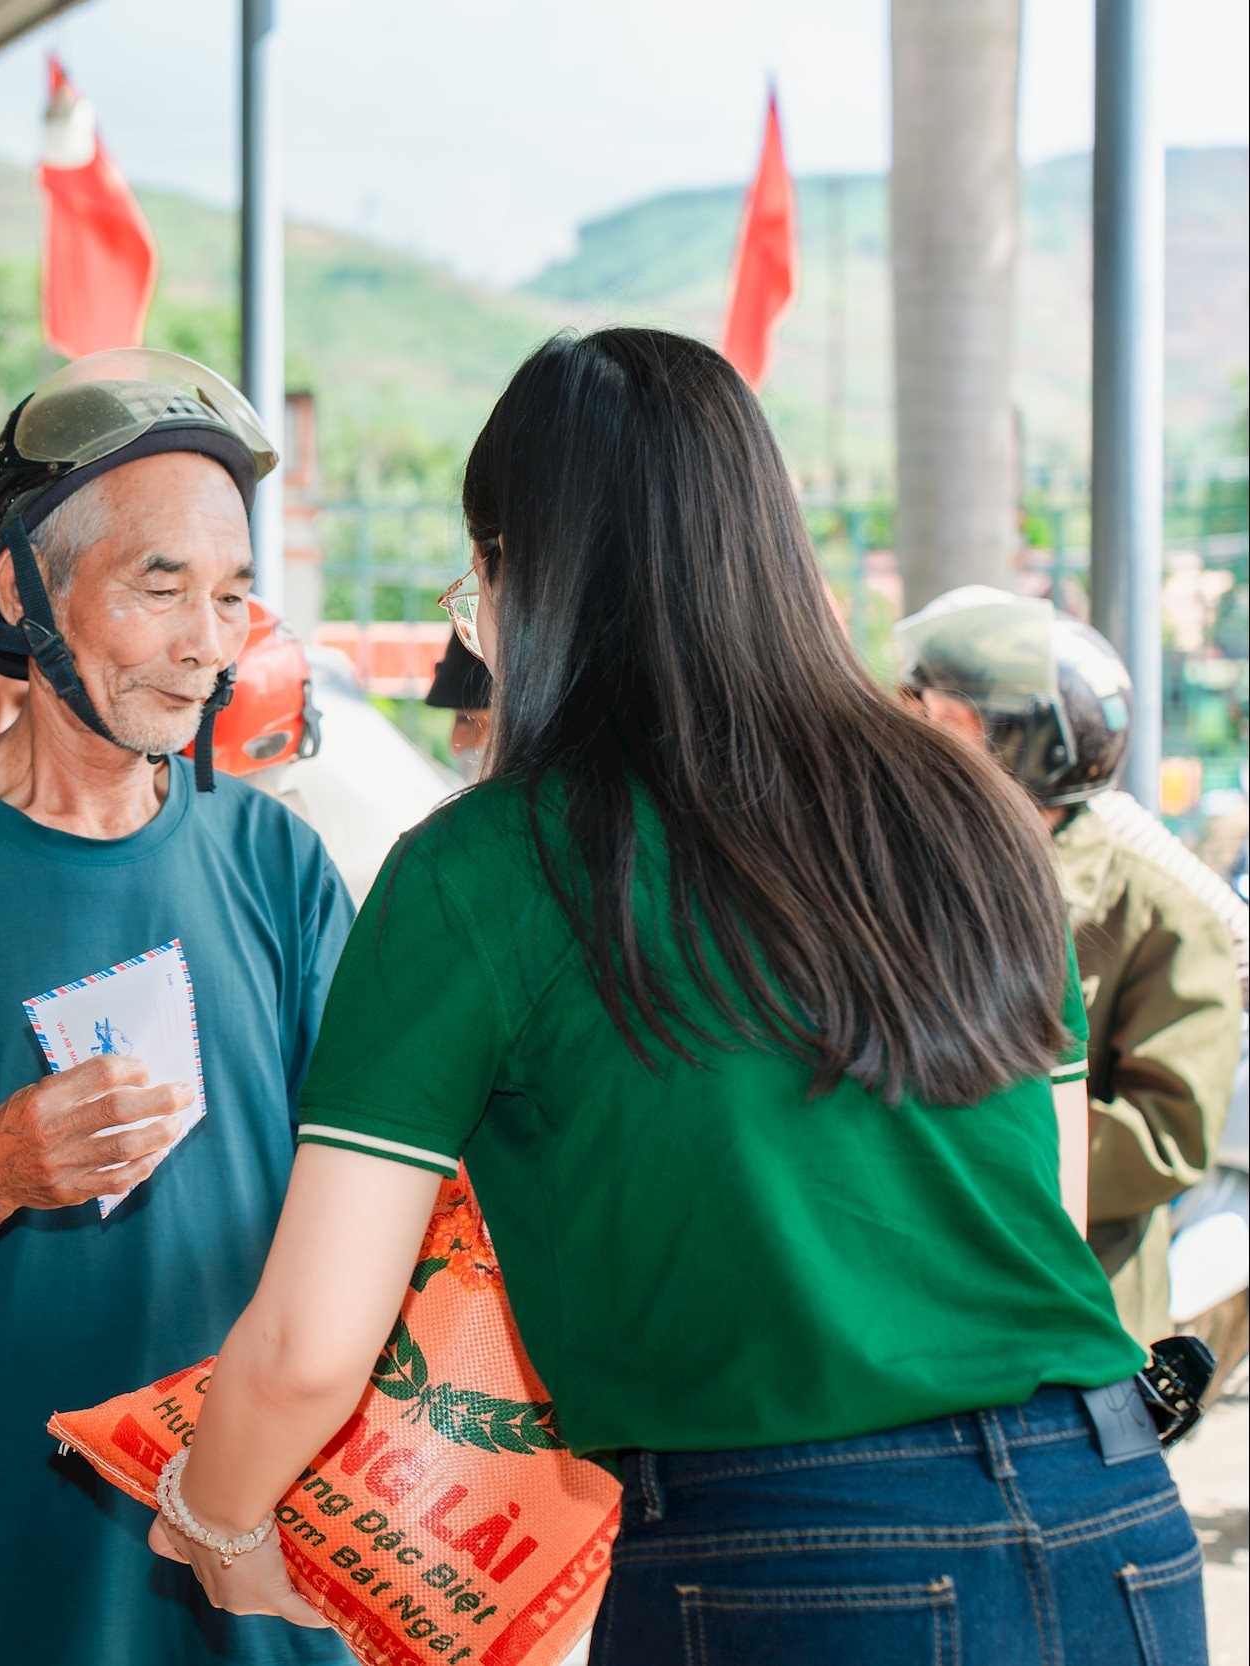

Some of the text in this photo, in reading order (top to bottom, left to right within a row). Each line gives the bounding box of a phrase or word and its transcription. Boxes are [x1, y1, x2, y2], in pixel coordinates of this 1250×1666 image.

[56, 1020, 80, 1067] VIA AIR MAI
[351, 1508, 424, 1566] Đặc
[420, 1562, 499, 1625] Biệt
[419, 1483, 540, 1585] LÀI
[329, 1544, 393, 1597] Bát
[388, 1593, 472, 1666] Ngát
